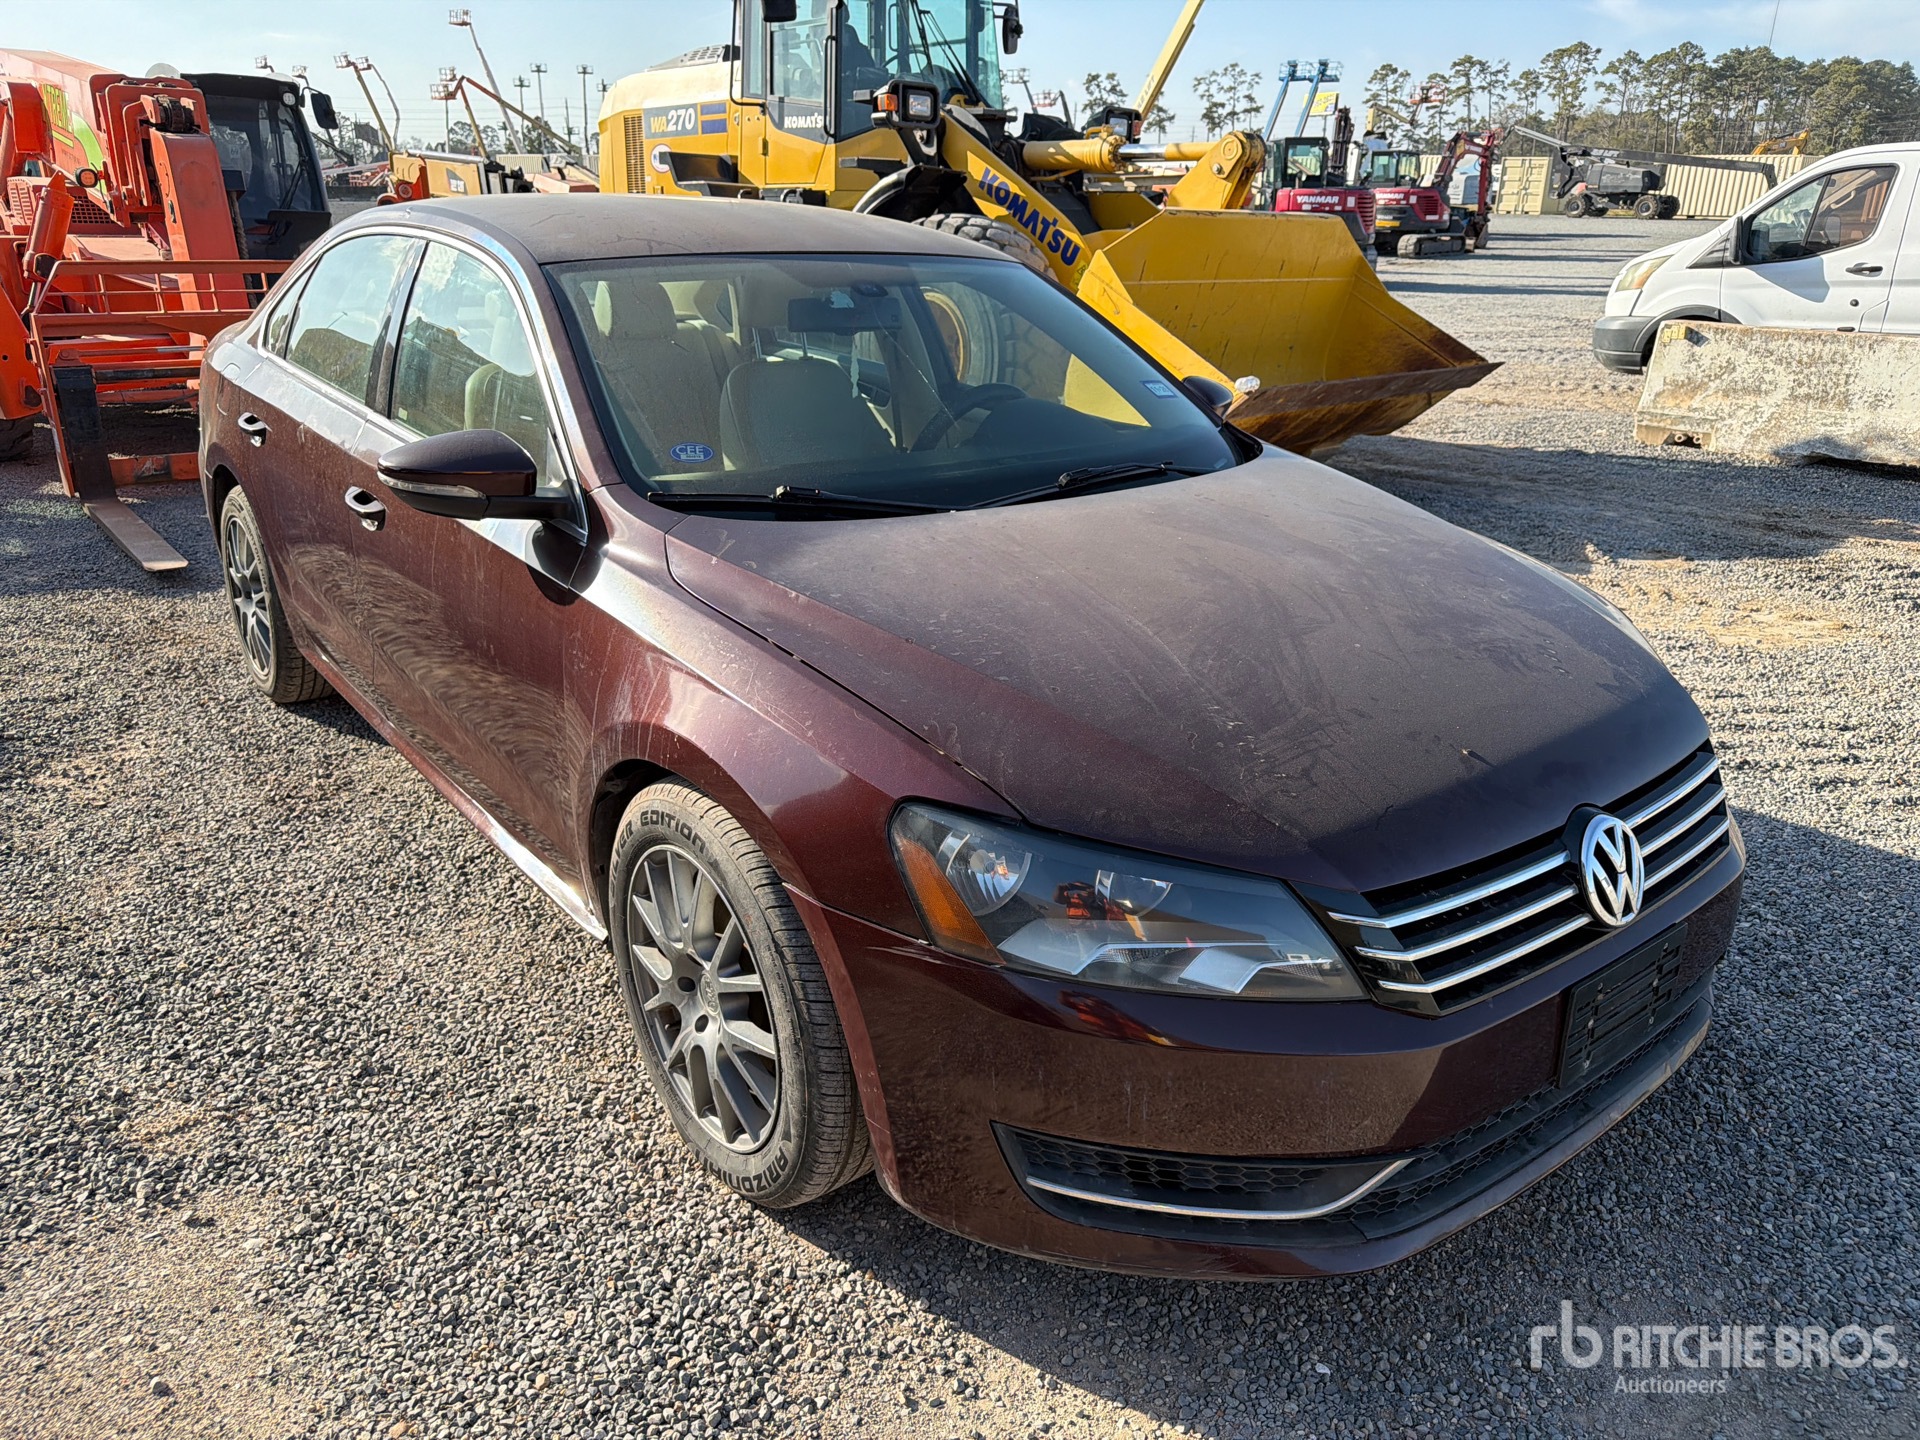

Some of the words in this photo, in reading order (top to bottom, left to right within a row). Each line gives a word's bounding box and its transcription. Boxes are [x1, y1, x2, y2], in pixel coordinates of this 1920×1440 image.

[651, 108, 696, 133] WA270
[784, 112, 825, 129] KOMATS
[1296, 194, 1340, 205] YANMAR
[978, 167, 1081, 266] KOMATSU
[675, 445, 704, 454] CEE
[640, 809, 706, 854] EDITION
